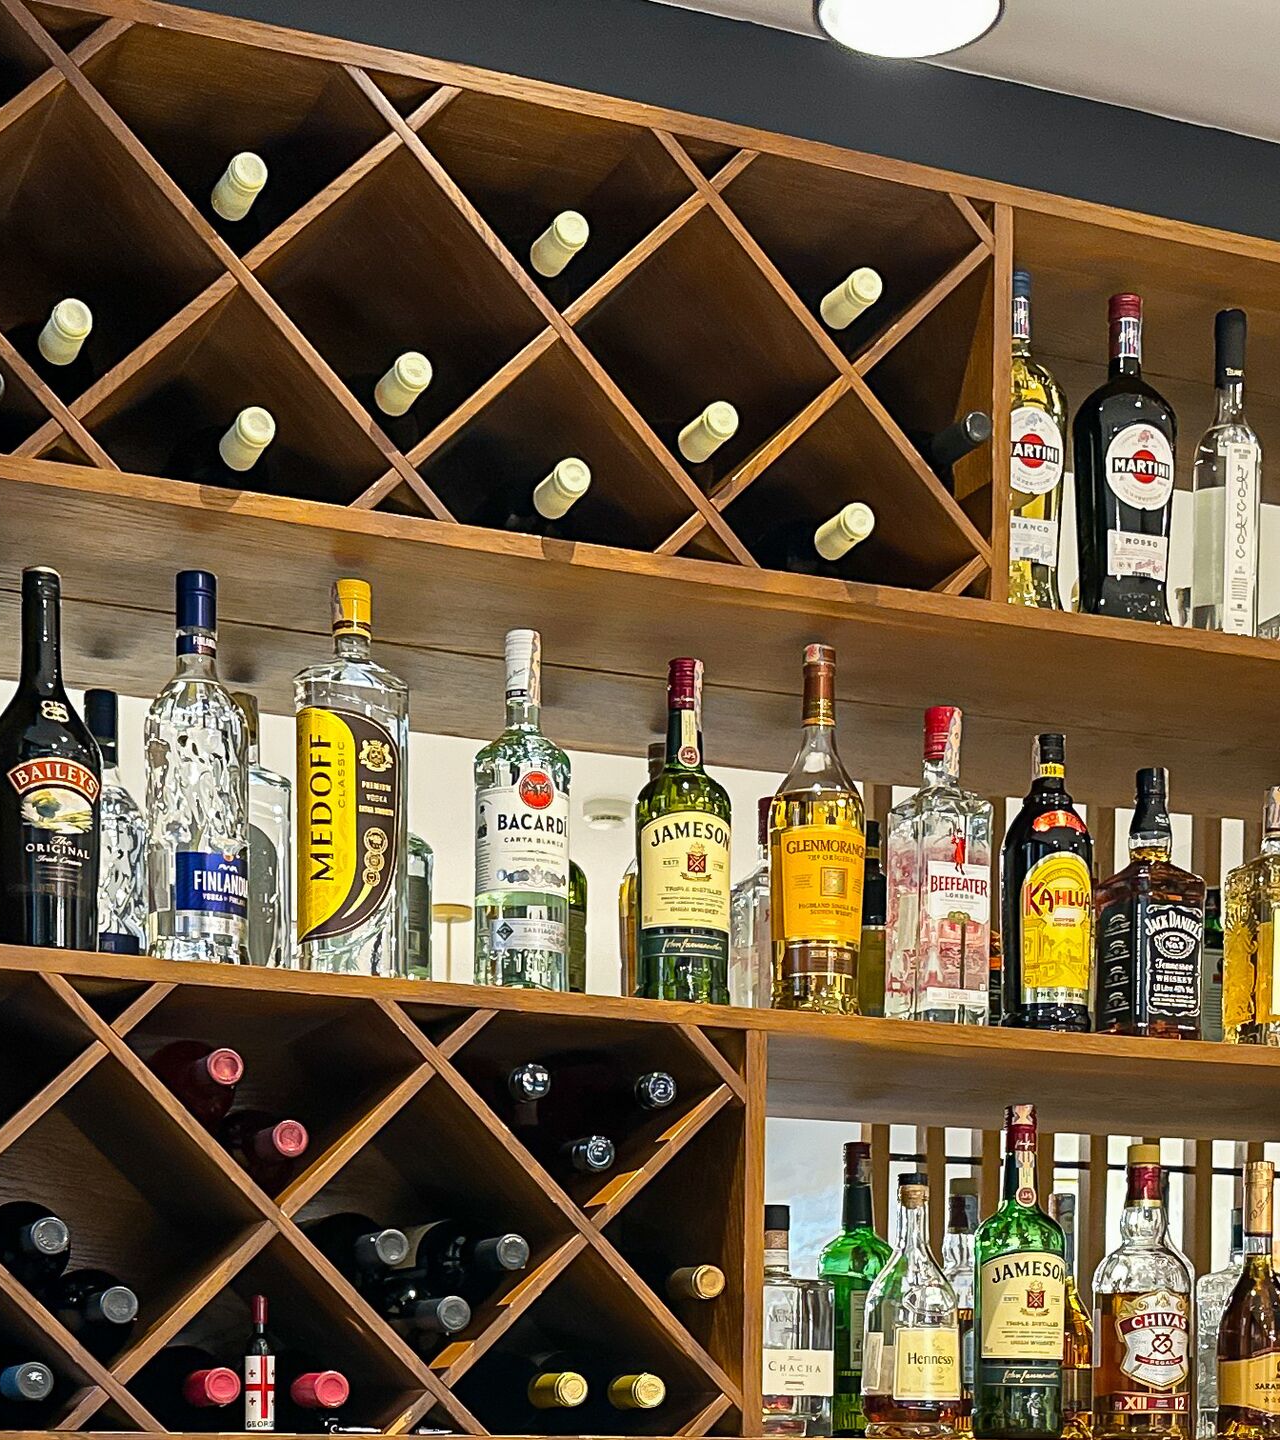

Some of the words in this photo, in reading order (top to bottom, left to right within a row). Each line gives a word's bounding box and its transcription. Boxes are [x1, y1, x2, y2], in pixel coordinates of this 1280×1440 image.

[1012, 443, 1059, 464] ARTINI
[1114, 458, 1170, 480] MARTINI
[1126, 538, 1158, 548] ROSSO
[16, 763, 98, 794] BAILEYS
[337, 741, 346, 808] CLASSIC
[309, 733, 334, 881] MEDOFF
[651, 821, 730, 852] JAMESON
[25, 843, 91, 860] ORIGINAL
[786, 839, 865, 859] GLENMORANG
[931, 875, 988, 897] BEEFEATER
[1025, 882, 1091, 918] KAHLÚA
[1145, 914, 1169, 936] JACK
[1169, 910, 1202, 941] DANIEL'S
[1156, 975, 1193, 984] WHISKEY
[992, 1261, 1065, 1285] JAMESON
[1131, 1314, 1187, 1330] CHIVAS
[907, 1352, 954, 1367] Hennessy
[1124, 1396, 1148, 1410] XII
[1174, 1397, 1185, 1410] 12
